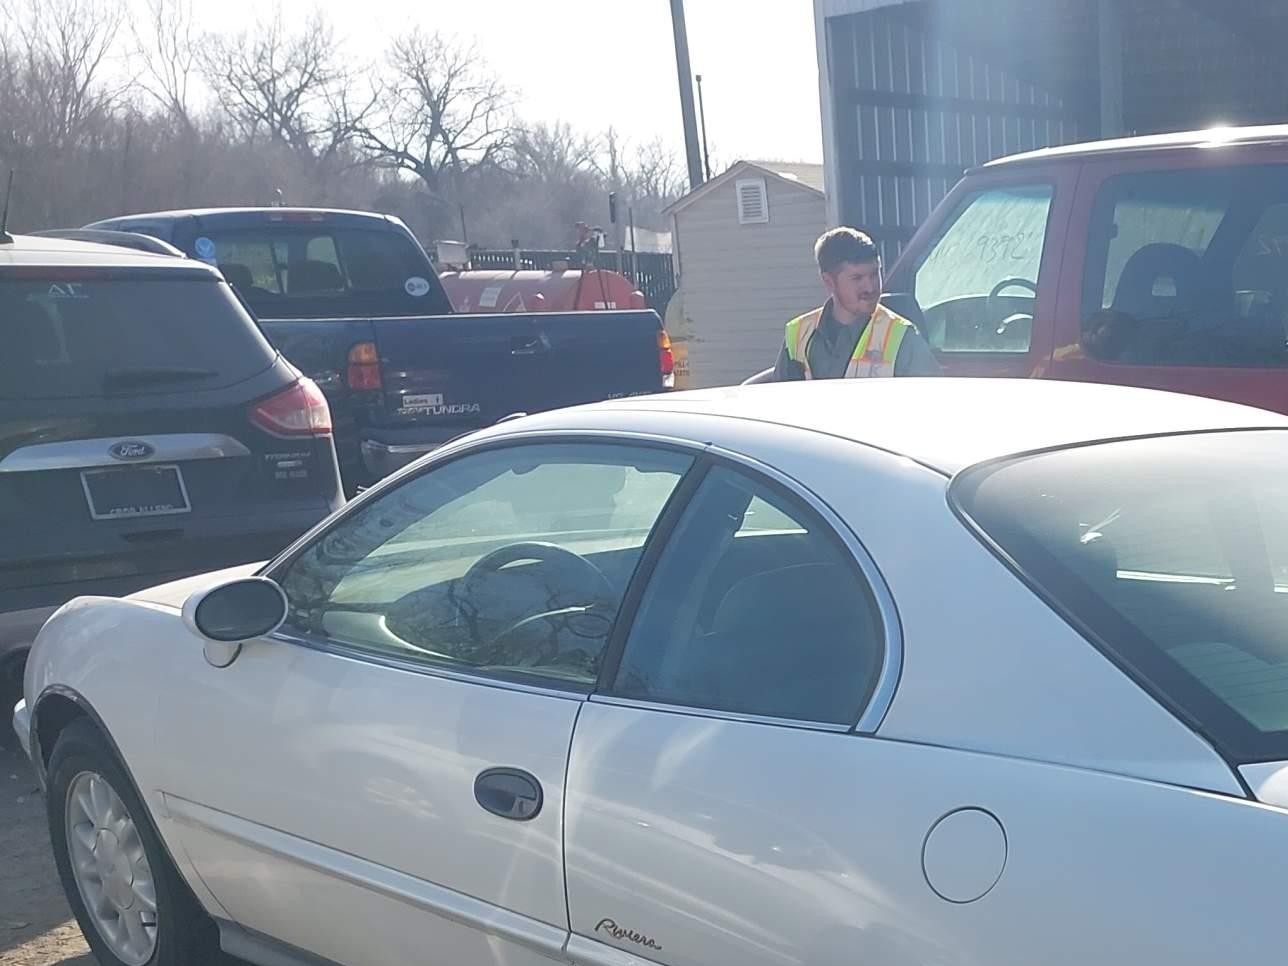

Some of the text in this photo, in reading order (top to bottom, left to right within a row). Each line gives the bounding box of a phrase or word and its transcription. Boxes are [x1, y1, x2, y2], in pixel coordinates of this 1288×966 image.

[424, 403, 480, 415] TUNDRA
[119, 444, 145, 457] Ford
[594, 918, 662, 950] Riviera
